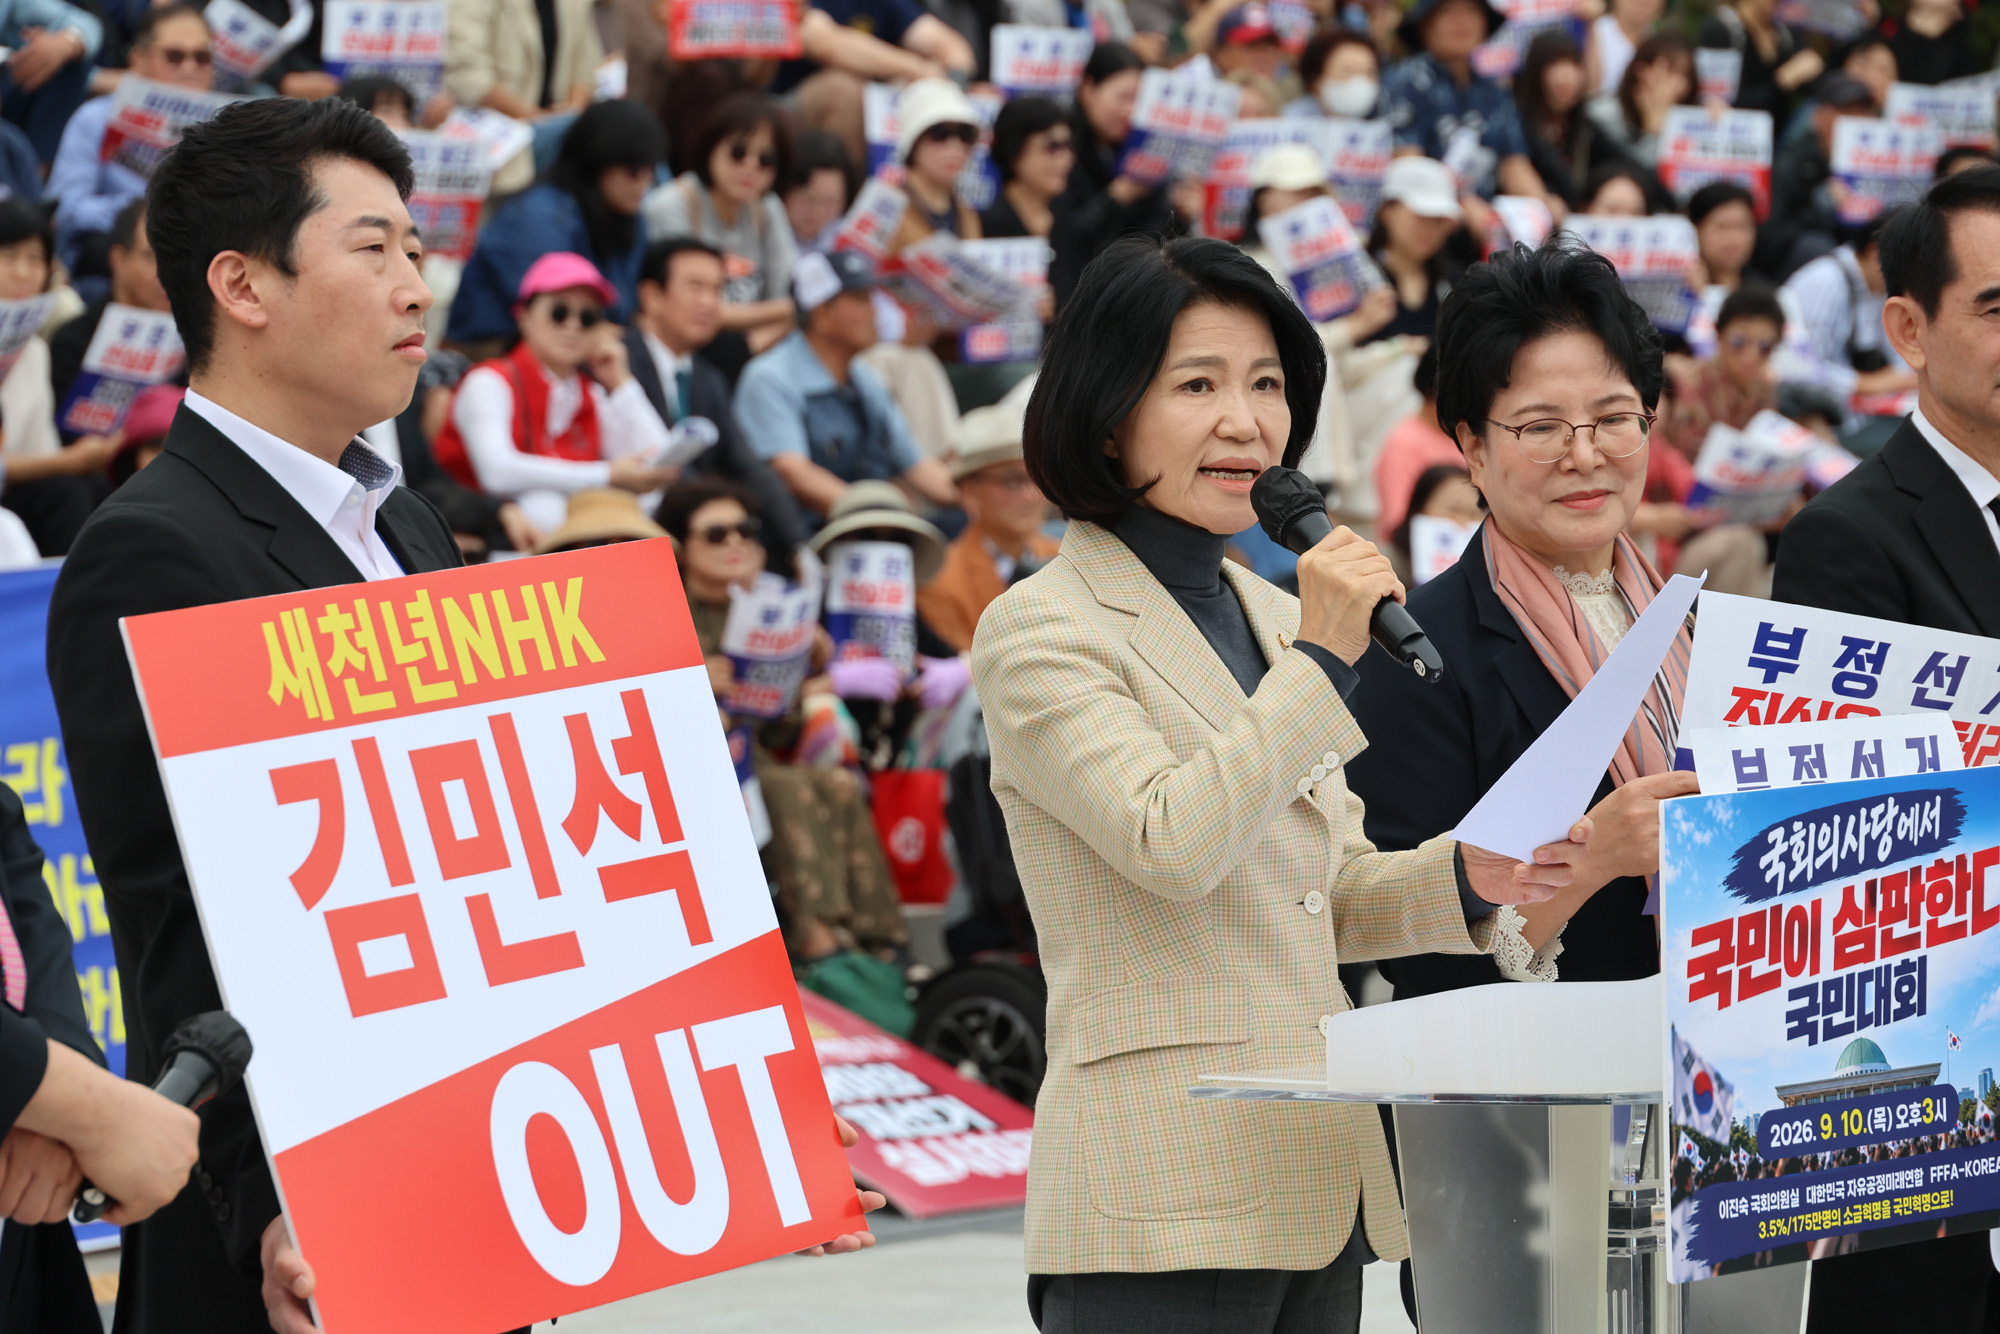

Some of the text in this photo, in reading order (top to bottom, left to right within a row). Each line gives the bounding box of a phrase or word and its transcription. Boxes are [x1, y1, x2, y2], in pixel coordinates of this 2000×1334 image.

[261, 576, 607, 721] 새천년NHK
[268, 688, 714, 1019] 김민석
[1758, 795, 1942, 896] 국회의사당에서
[1687, 897, 1822, 1012] 국민이
[1785, 954, 1928, 1047] 국민대회
[490, 1005, 813, 1287] OUT
[1770, 1119, 1817, 1148] 2026.
[1719, 1199, 1749, 1220] 이진숙
[1750, 1187, 1800, 1213] 국회의원실
[1806, 1181, 1845, 1205] 대한민국
[1847, 1167, 1924, 1198] 자유공정미래연합
[1758, 1189, 1954, 1240] 3.5%/175만명의 소금혁명을 국민혁명으로!
